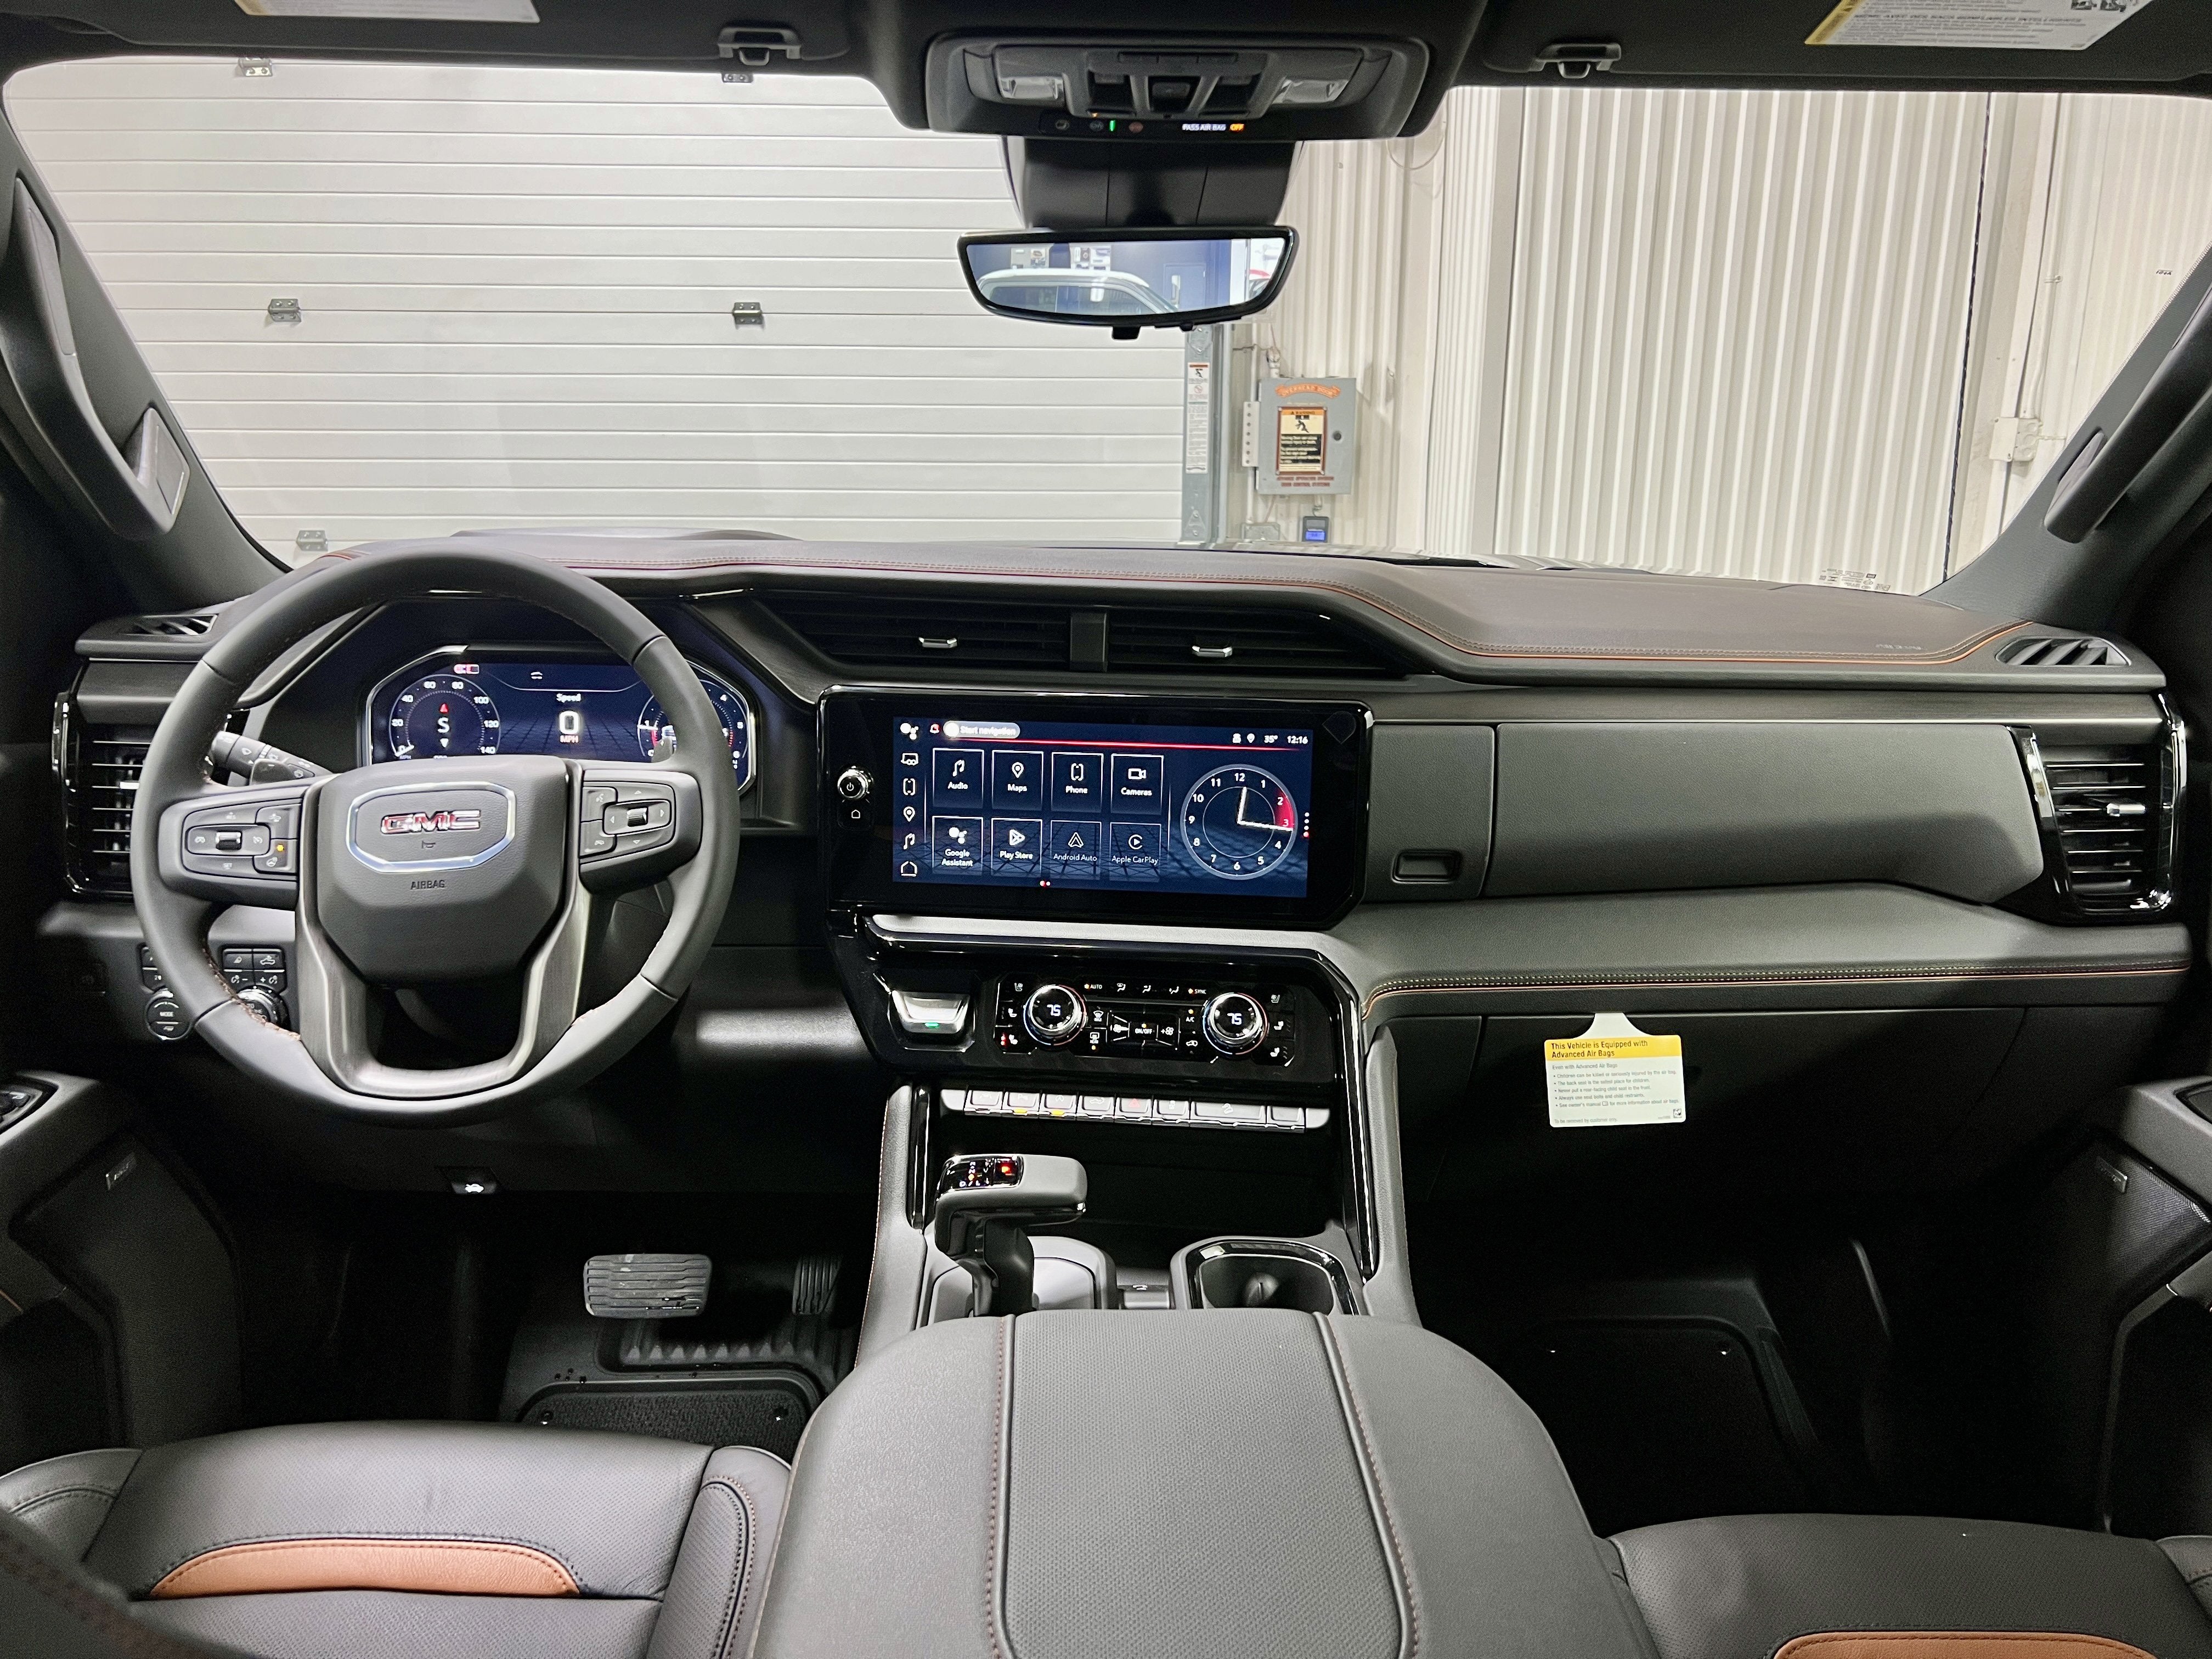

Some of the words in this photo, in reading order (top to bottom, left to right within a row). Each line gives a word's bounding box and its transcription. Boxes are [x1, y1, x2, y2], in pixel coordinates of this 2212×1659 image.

[401, 695, 414, 703] 40
[473, 696, 489, 704] 100
[556, 693, 582, 703] Speed
[392, 719, 404, 727] 20
[438, 717, 450, 733] S
[484, 720, 499, 728] 120
[559, 710, 579, 735] 0
[1287, 736, 1308, 744] 12:16
[1234, 772, 1245, 782] 12
[1211, 778, 1221, 787] 11
[1261, 780, 1266, 788] 1
[1007, 784, 1028, 793] Maps
[1065, 786, 1088, 794] Phone
[1120, 787, 1152, 796] Cameras
[1192, 793, 1204, 803] 10
[1277, 797, 1284, 805] 2
[380, 809, 481, 834] GMC
[1188, 815, 1195, 824] 9
[1193, 837, 1200, 847] 8
[1274, 840, 1282, 849] 4
[945, 849, 970, 858] Google
[1000, 851, 1014, 860] Play
[1015, 851, 1033, 859] Store
[941, 859, 973, 867] Assistant
[1111, 855, 1131, 864] Apple
[1133, 856, 1158, 865] CarPlay
[1210, 854, 1217, 863] 7
[1257, 856, 1264, 865] 5
[1234, 861, 1240, 871] 6
[411, 880, 445, 890] AIRBAG
[1047, 1005, 1061, 1017] 75
[1227, 1013, 1242, 1025] 75
[1601, 1041, 1632, 1049] Equipped
